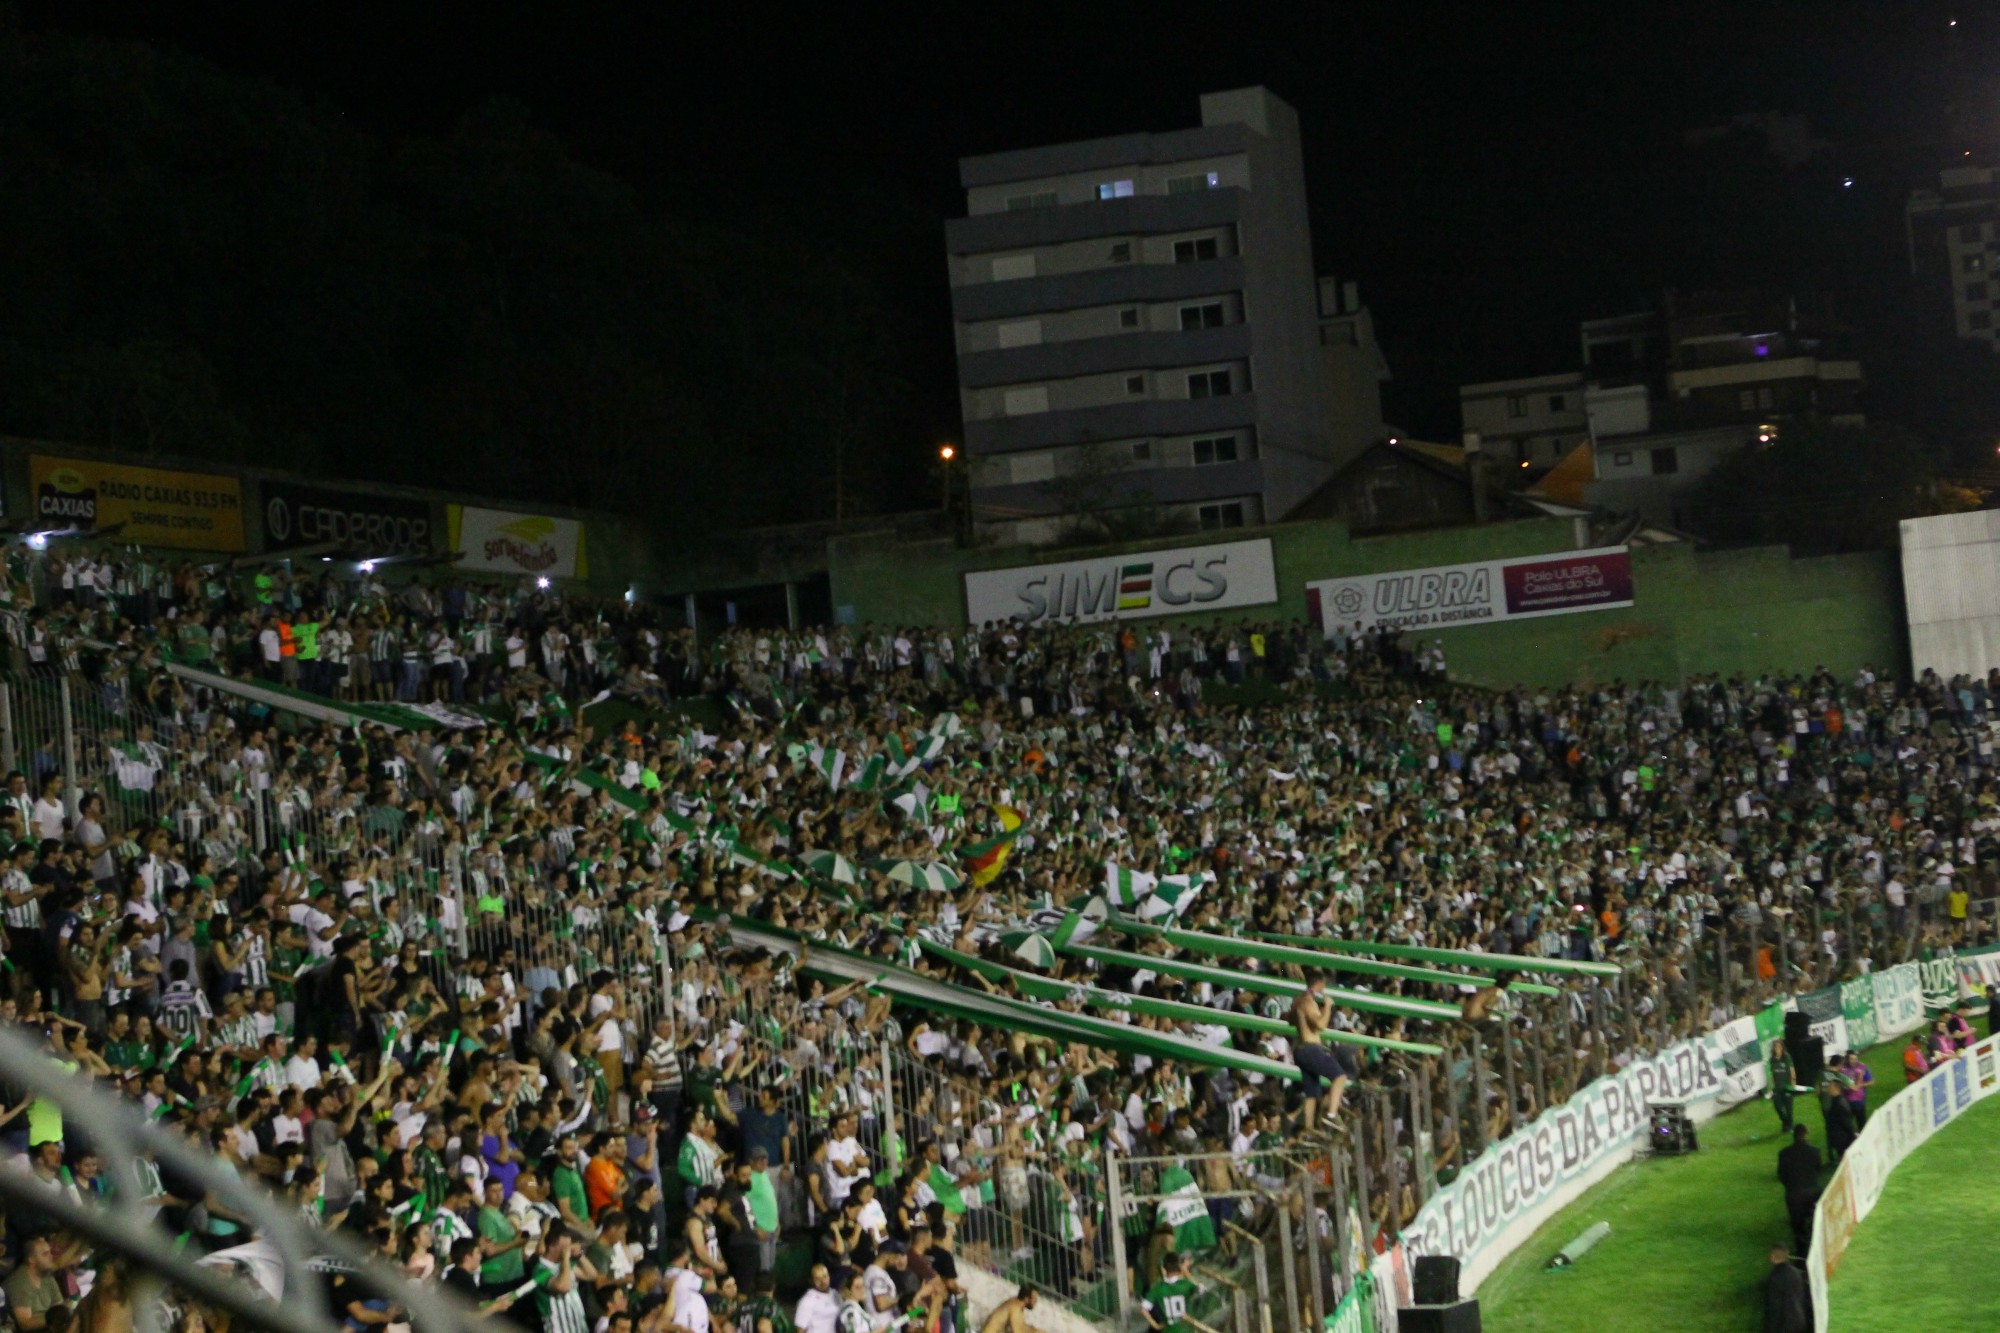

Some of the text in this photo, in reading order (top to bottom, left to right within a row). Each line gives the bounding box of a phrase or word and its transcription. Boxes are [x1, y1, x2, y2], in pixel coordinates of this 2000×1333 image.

[144, 486, 190, 505] CAXIAS
[40, 496, 95, 518] CAXIAS
[1524, 574, 1605, 595] Caxias do Sul
[1525, 565, 1600, 583] Polo ULBRA
[1016, 555, 1228, 622] SIMECS
[1373, 568, 1491, 615] ULBRA
[1431, 613, 1439, 622] A
[1441, 606, 1493, 622] DISTÂNCIA
[1443, 1127, 1555, 1258] LOUCOS
[1557, 1101, 1600, 1170] DA
[1603, 1045, 1718, 1139] PAPADA
[1162, 1294, 1186, 1319] 10
